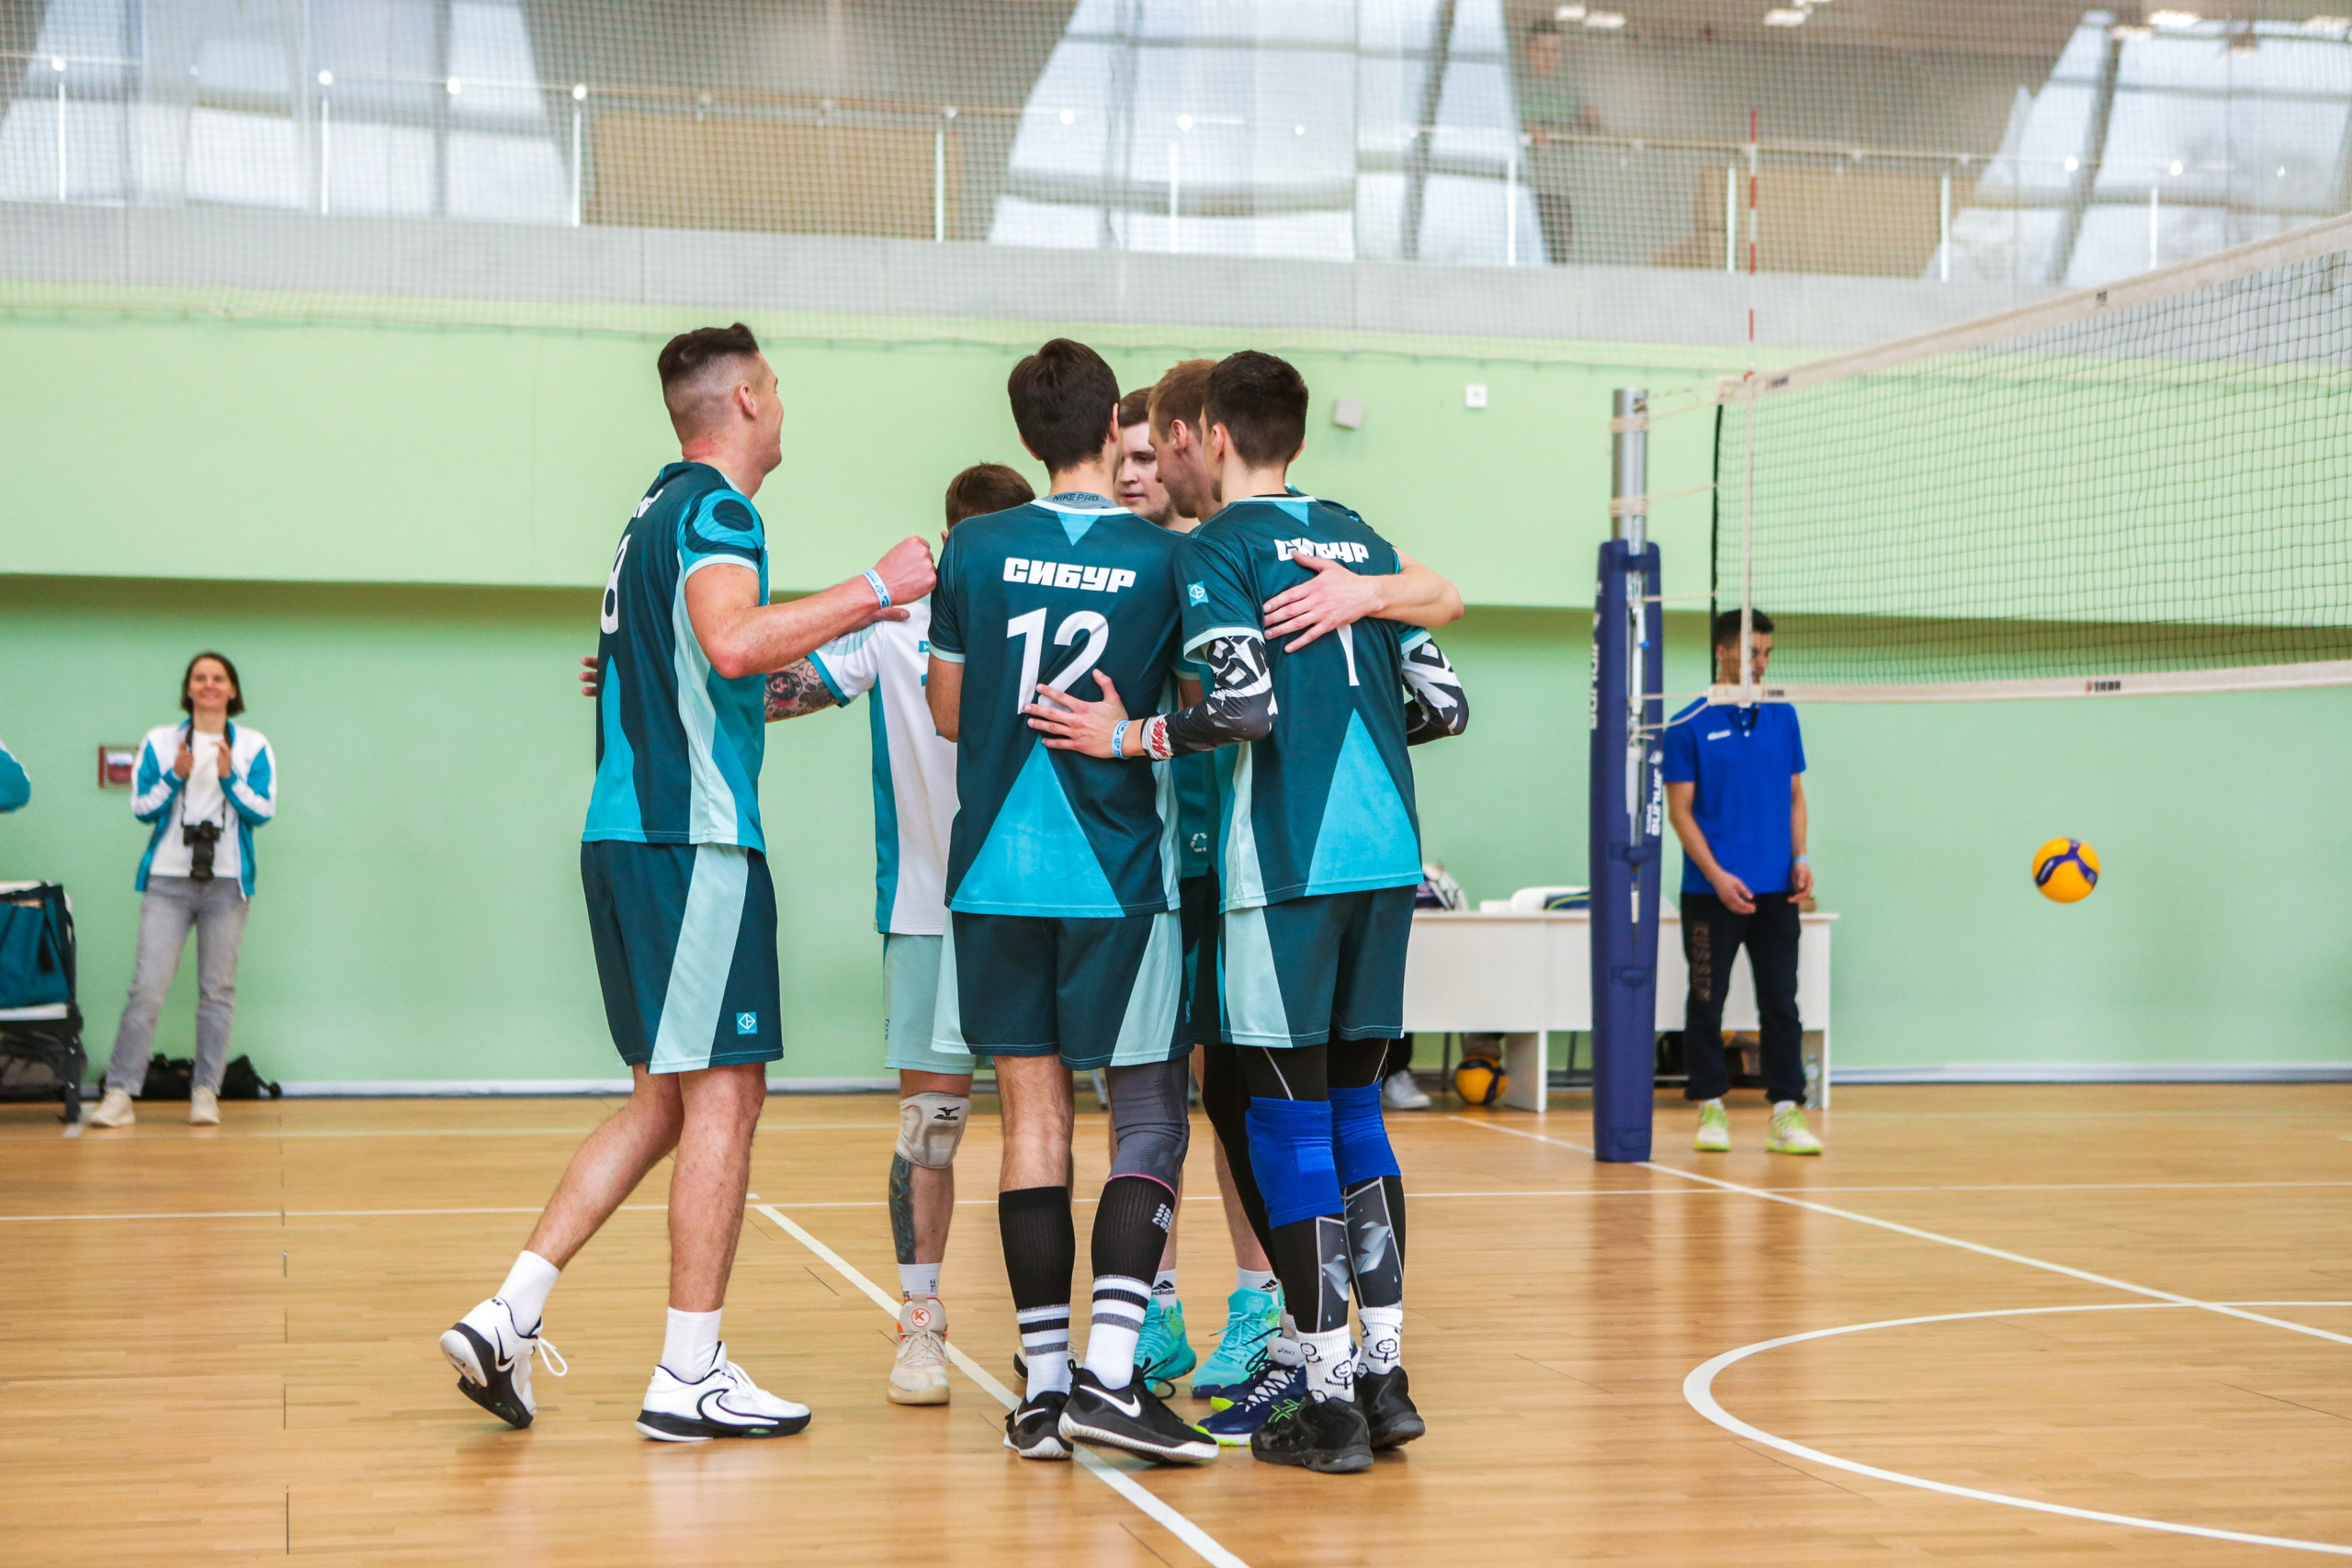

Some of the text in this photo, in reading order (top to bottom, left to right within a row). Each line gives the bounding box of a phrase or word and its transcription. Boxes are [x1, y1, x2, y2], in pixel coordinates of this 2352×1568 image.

[1052, 493, 1099, 502] NIKE PRO
[1002, 557, 1136, 593] СИБУР
[1006, 607, 1109, 715] 12
